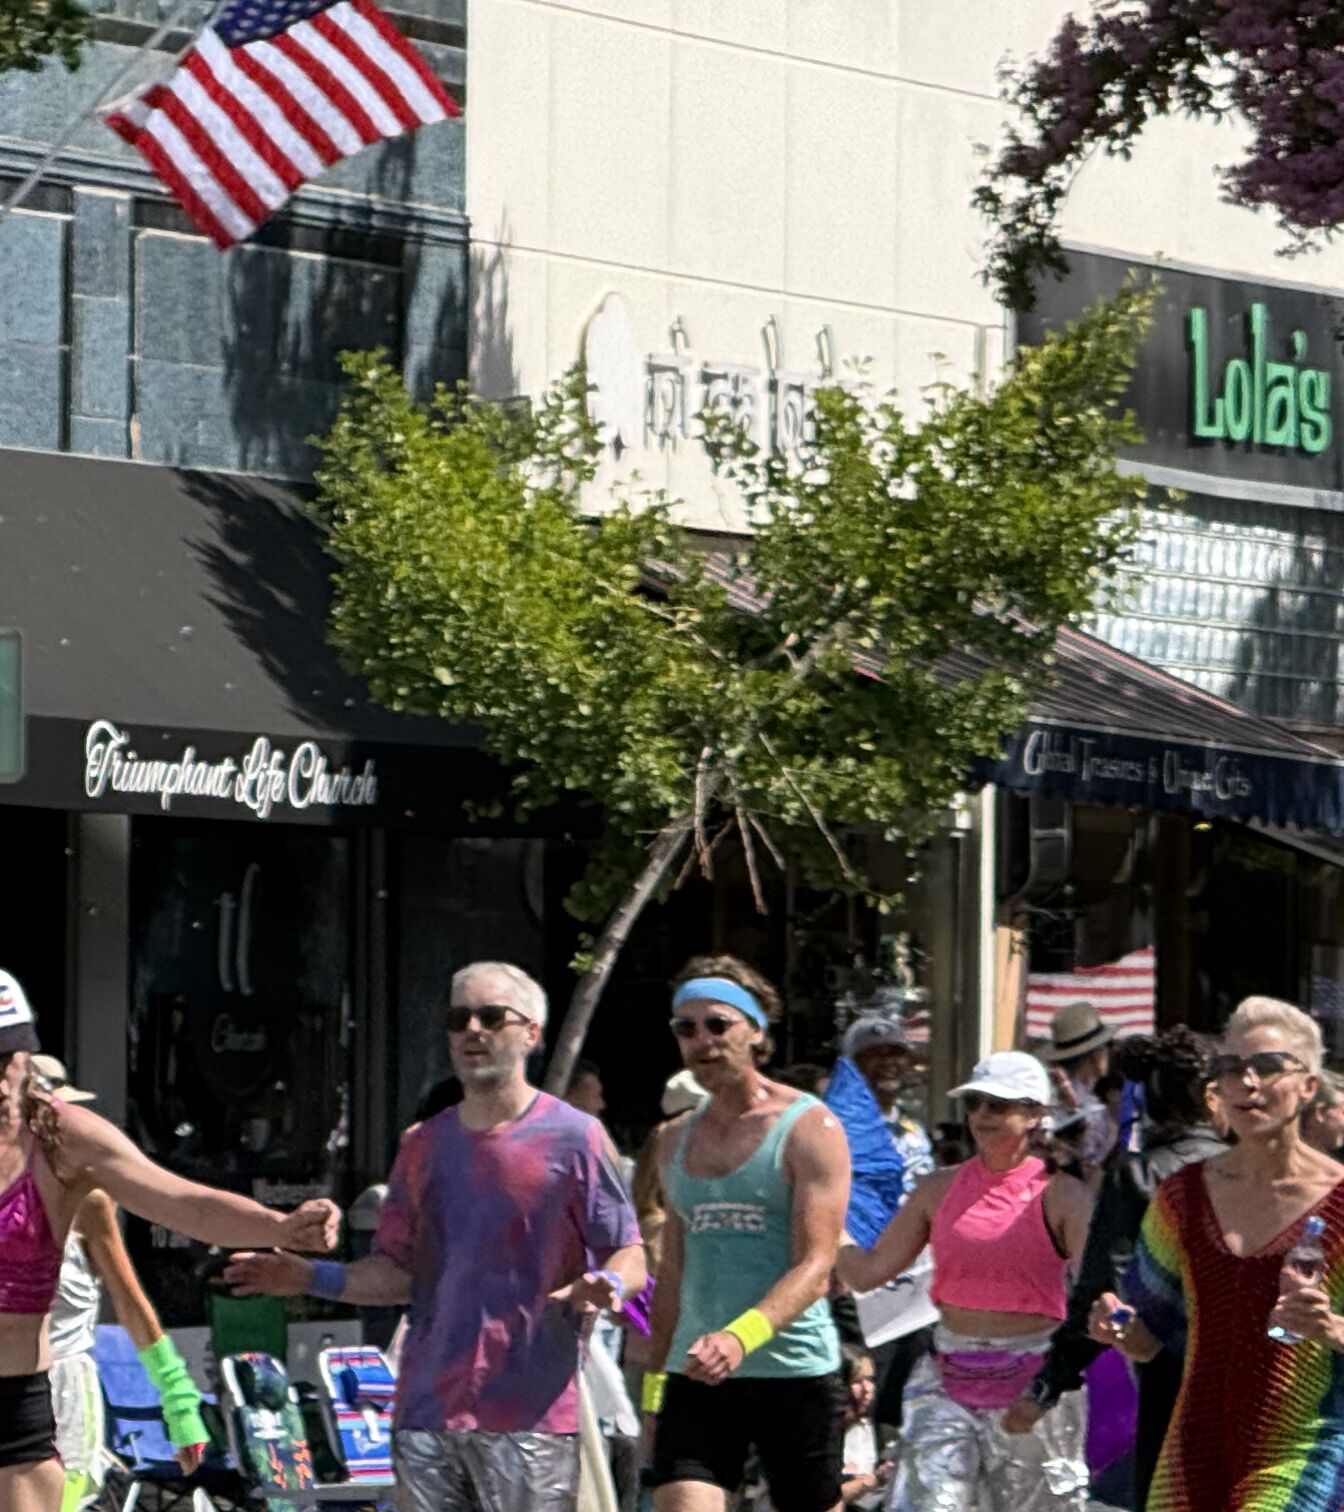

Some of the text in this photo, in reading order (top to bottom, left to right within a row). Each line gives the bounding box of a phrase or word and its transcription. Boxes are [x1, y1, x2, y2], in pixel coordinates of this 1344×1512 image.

[1190, 302, 1333, 453] Lola's
[85, 719, 379, 819] Triumphant Life Church
